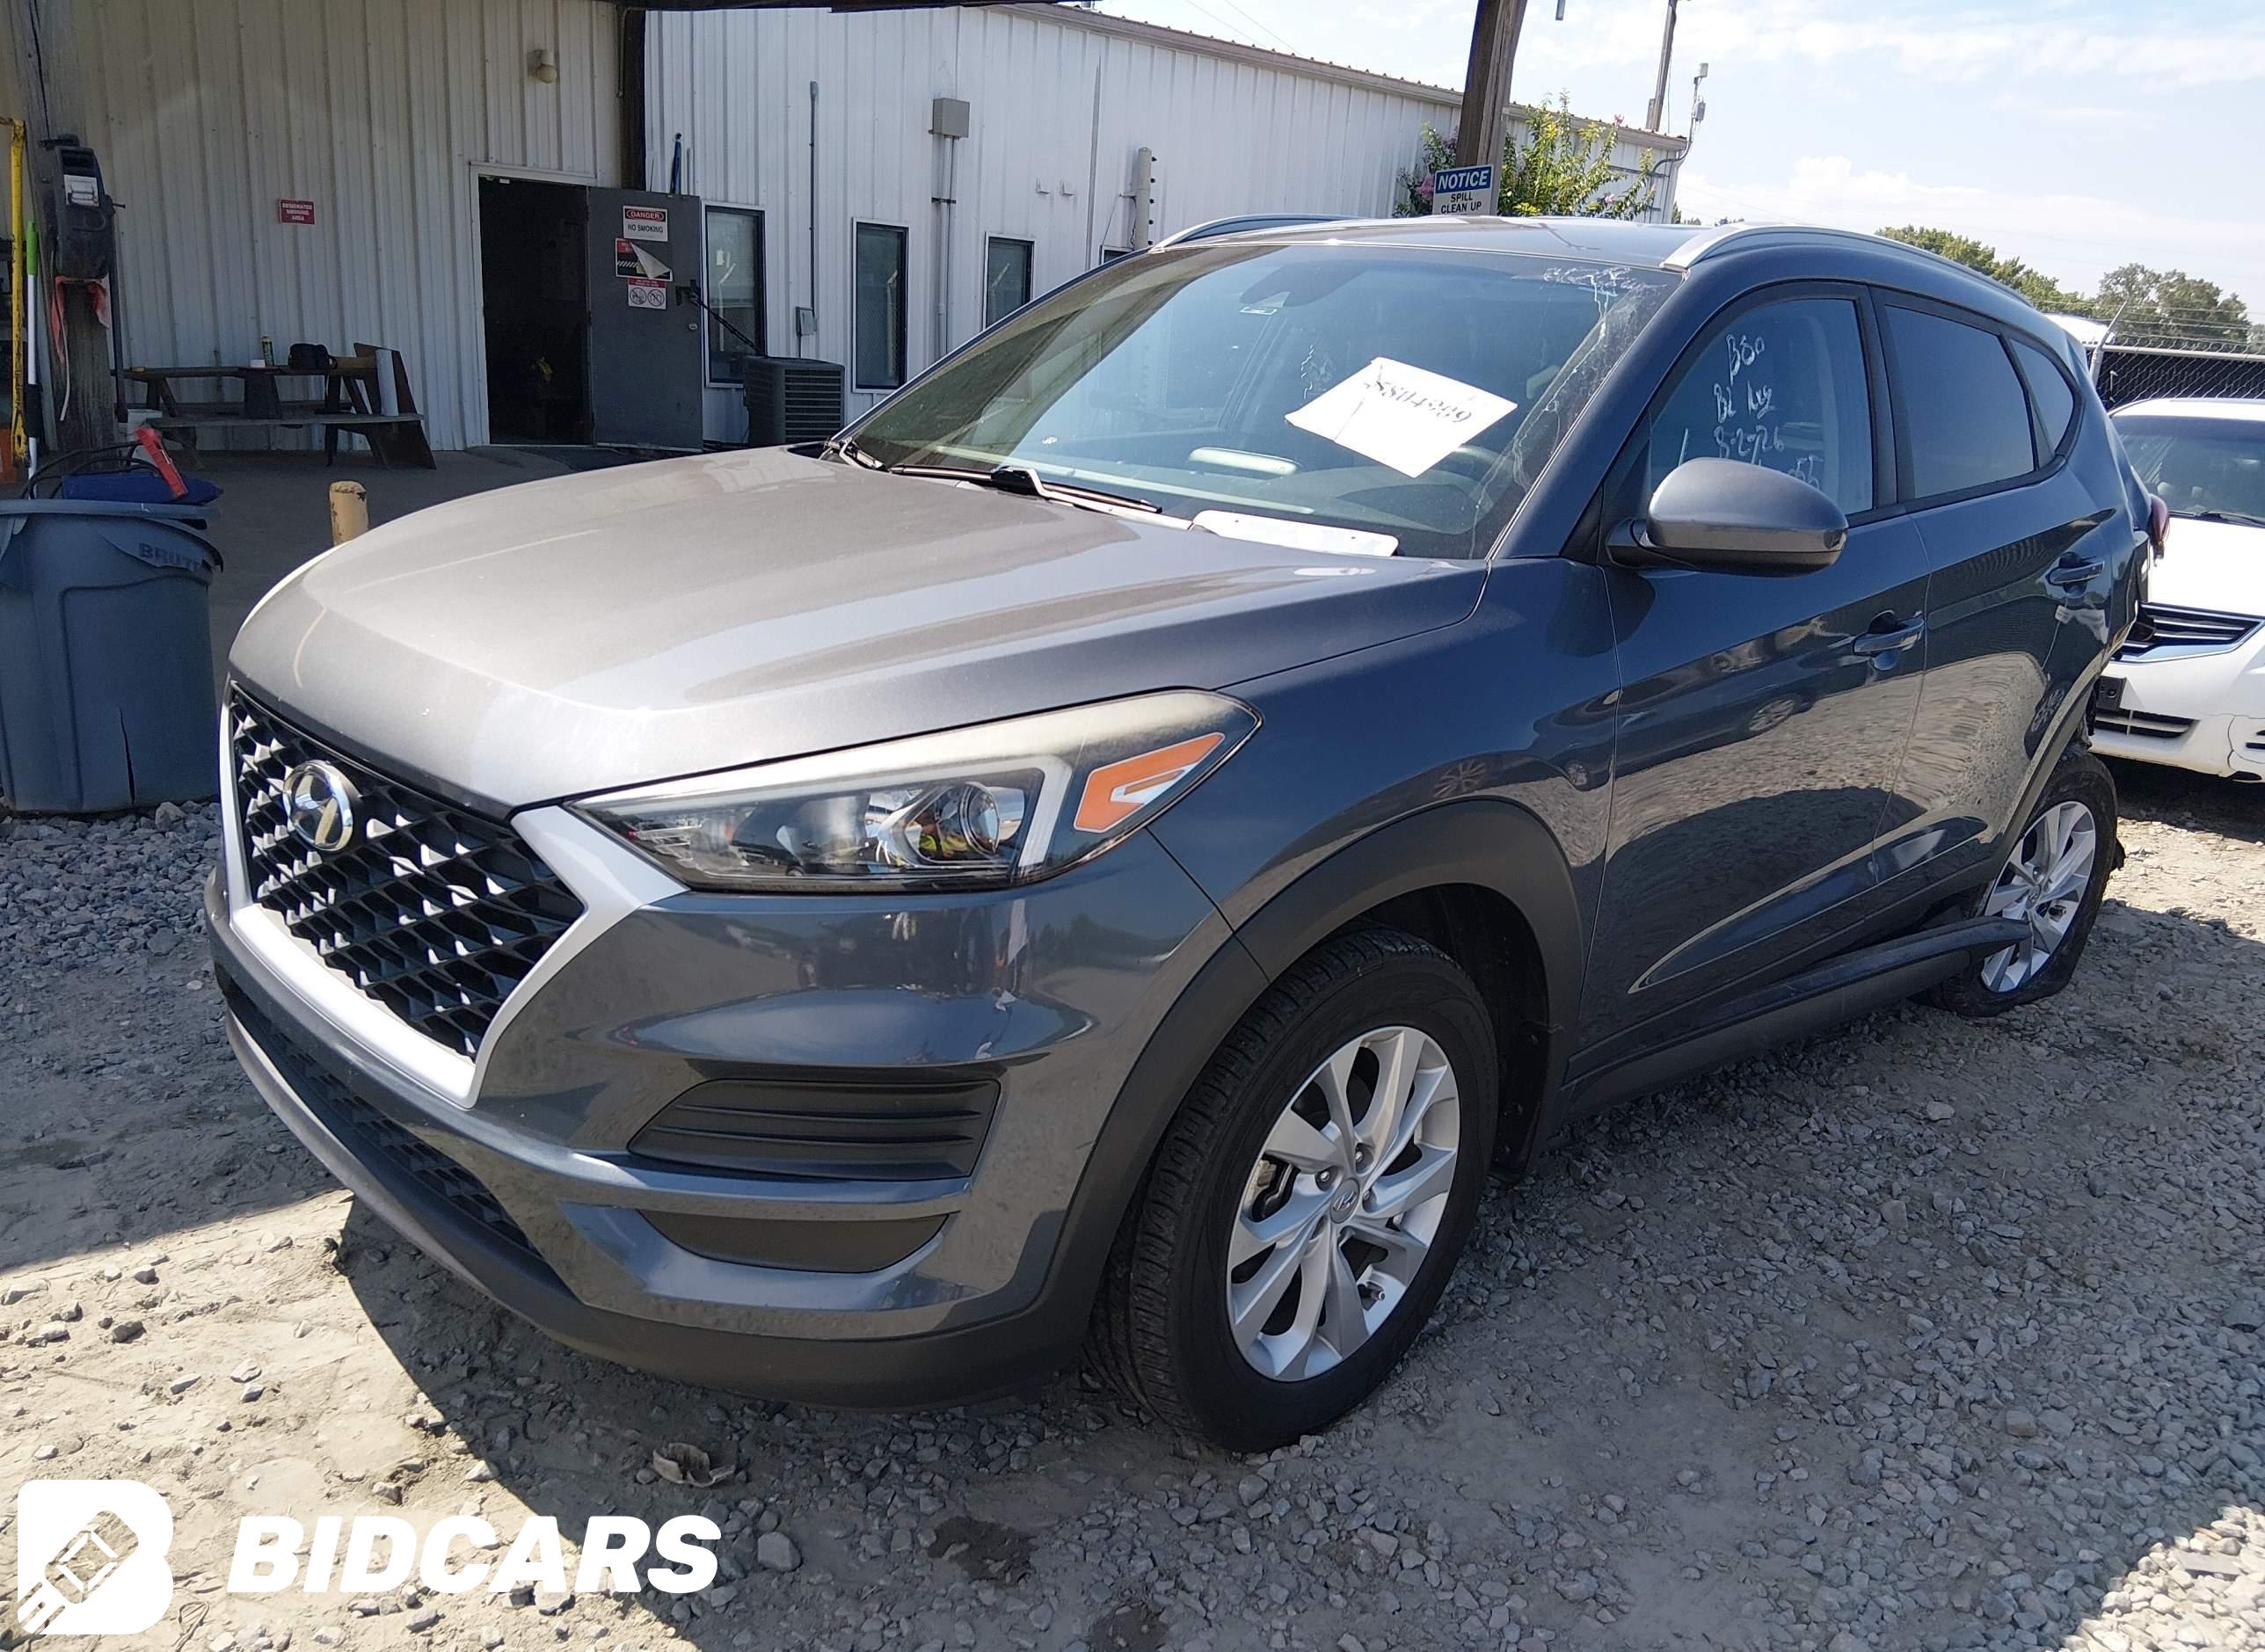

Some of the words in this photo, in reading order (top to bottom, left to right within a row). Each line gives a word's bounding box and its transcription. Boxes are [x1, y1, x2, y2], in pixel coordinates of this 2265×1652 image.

[1438, 170, 1489, 190] NOTICE
[1450, 192, 1473, 203] SPILL
[1440, 204, 1468, 214] CLEAN
[1470, 201, 1482, 212] UP
[630, 210, 660, 219] DANGER
[637, 224, 664, 233] SMOKING
